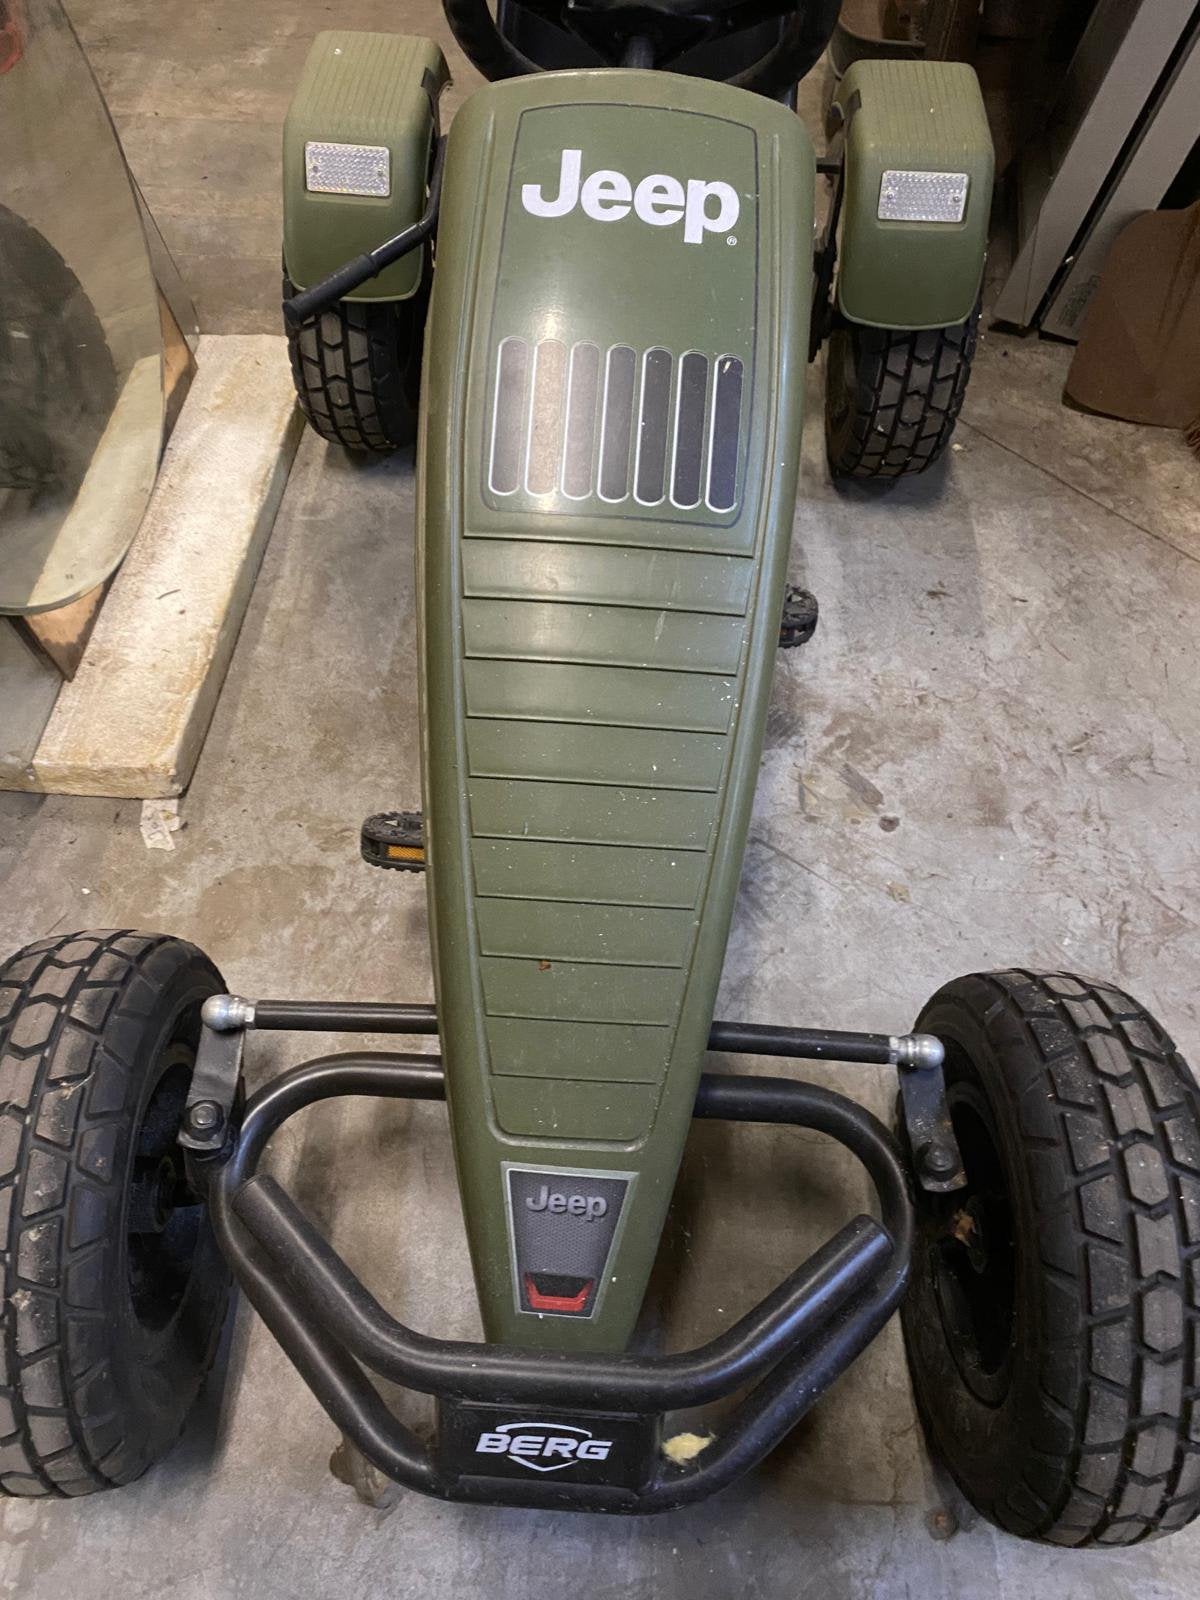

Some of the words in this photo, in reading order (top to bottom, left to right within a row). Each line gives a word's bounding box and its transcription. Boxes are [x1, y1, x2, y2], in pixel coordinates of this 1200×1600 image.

[521, 149, 740, 244] Jeep
[525, 1185, 607, 1222] Jeep
[475, 1432, 614, 1461] BERG
